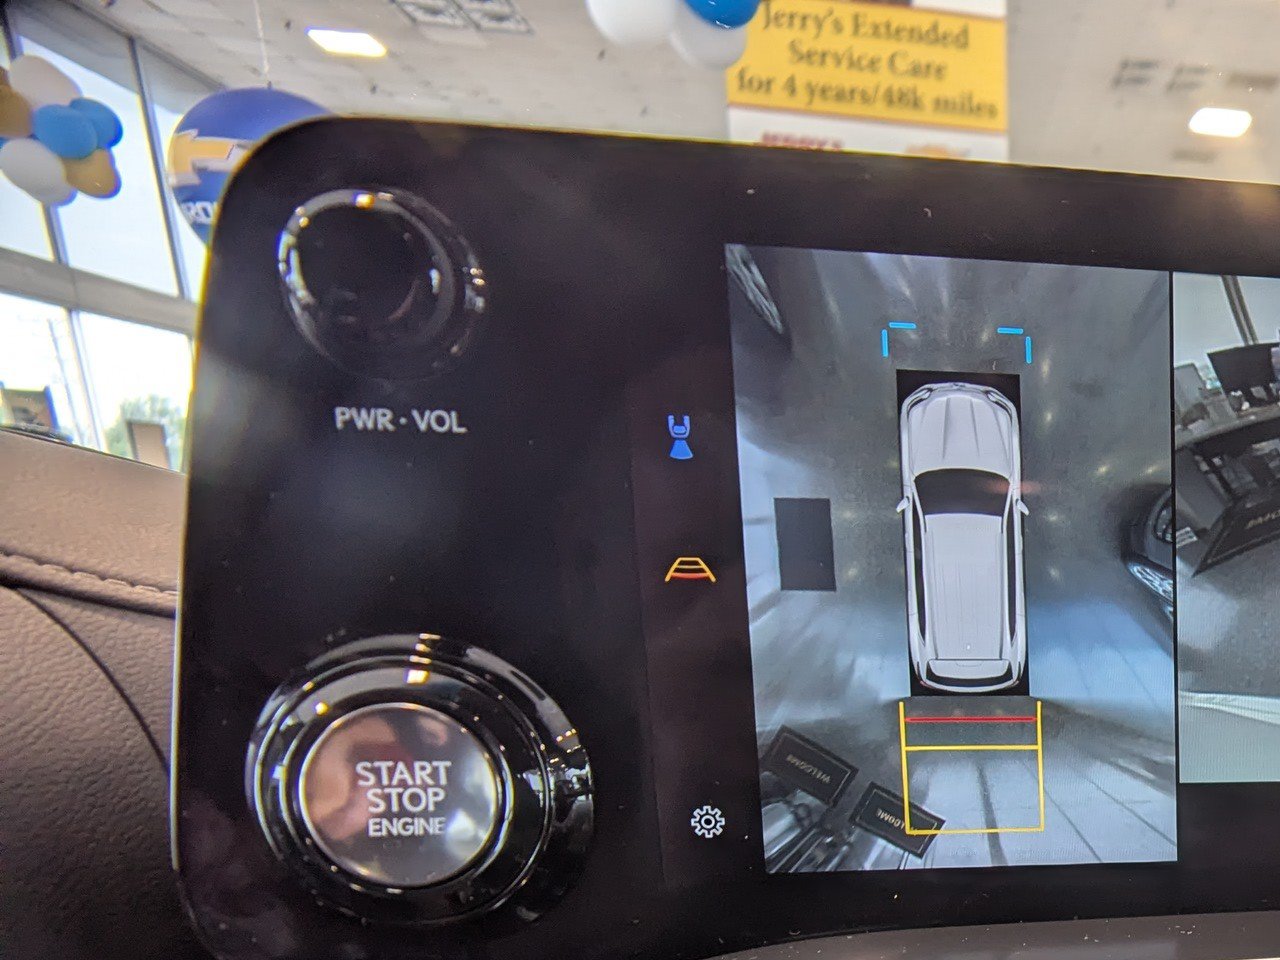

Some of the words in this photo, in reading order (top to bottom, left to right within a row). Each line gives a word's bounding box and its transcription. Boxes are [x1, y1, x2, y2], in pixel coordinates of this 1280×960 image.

[763, 0, 844, 38] Jerry's
[853, 13, 969, 50] Extended
[789, 38, 881, 74] Service
[888, 51, 947, 81] Care
[736, 66, 775, 94] for
[783, 74, 797, 97] 4
[932, 93, 998, 119] miles
[334, 406, 396, 432] PWR
[411, 408, 469, 434] VOL
[355, 760, 452, 787] START
[366, 787, 446, 813] STOP
[368, 816, 447, 838] ENGINE
